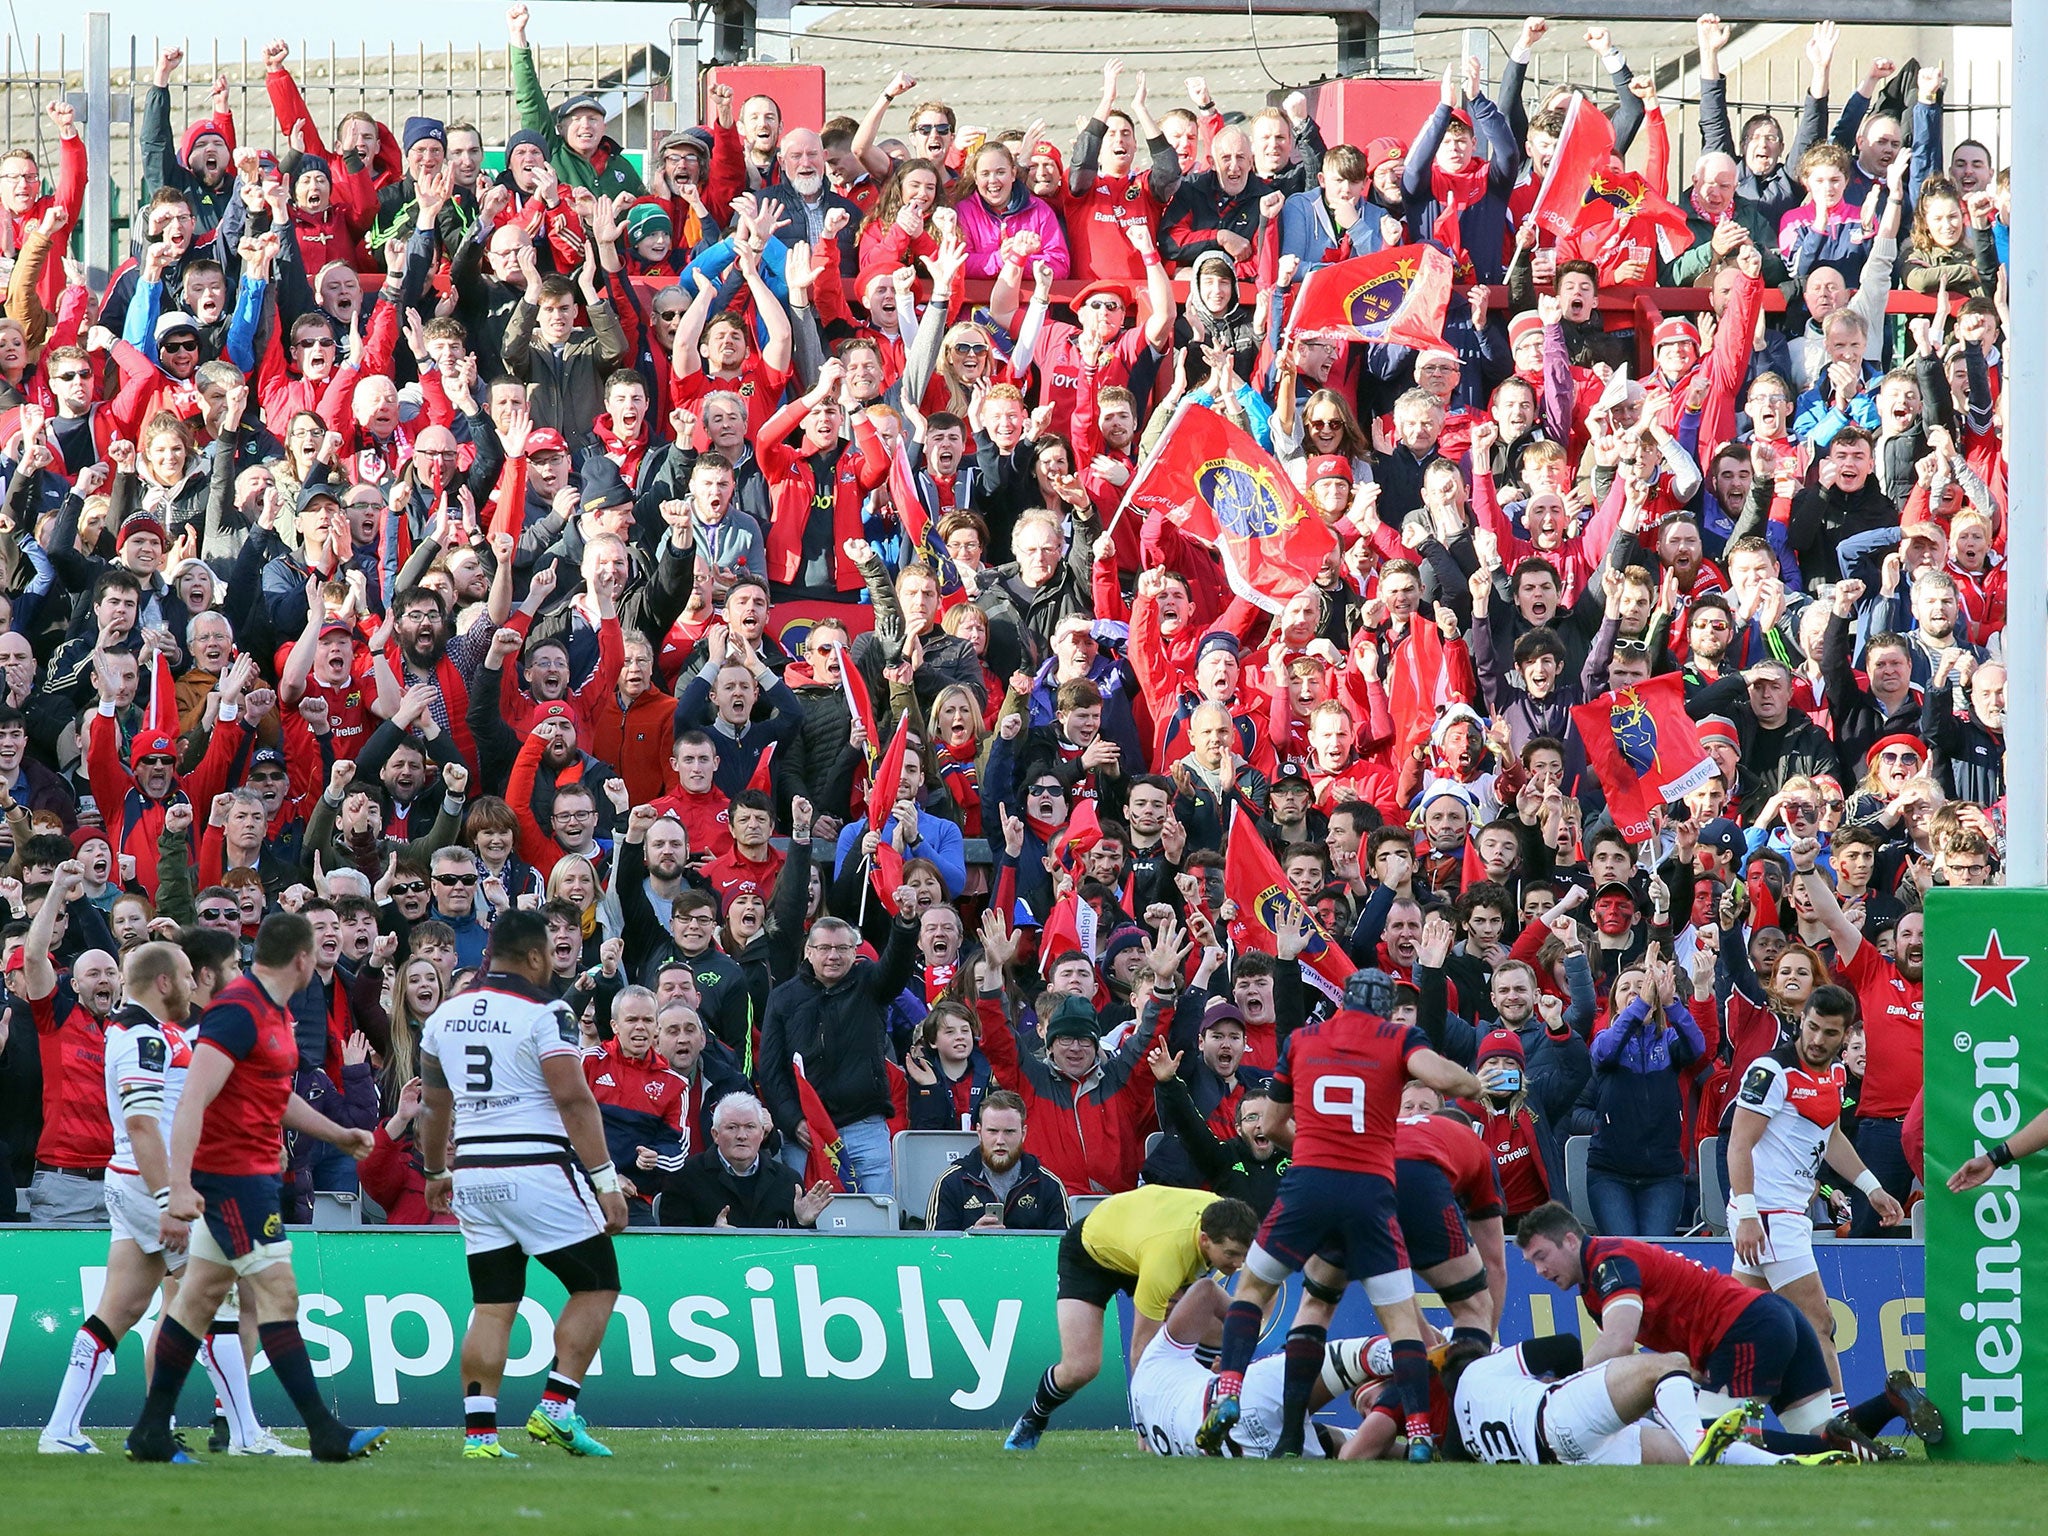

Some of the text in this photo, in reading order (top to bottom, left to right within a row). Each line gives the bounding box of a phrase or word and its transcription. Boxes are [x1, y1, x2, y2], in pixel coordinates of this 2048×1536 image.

[1349, 272, 1396, 299] MUNSTER
[1662, 783, 1687, 799] Bank
[1686, 774, 1697, 788] of
[444, 1020, 512, 1035] FIDUCIAL
[465, 1045, 493, 1093] 3
[1313, 1074, 1366, 1134] 9
[948, 1152, 959, 1160] 55
[79, 1265, 1023, 1411] Rsponsibly
